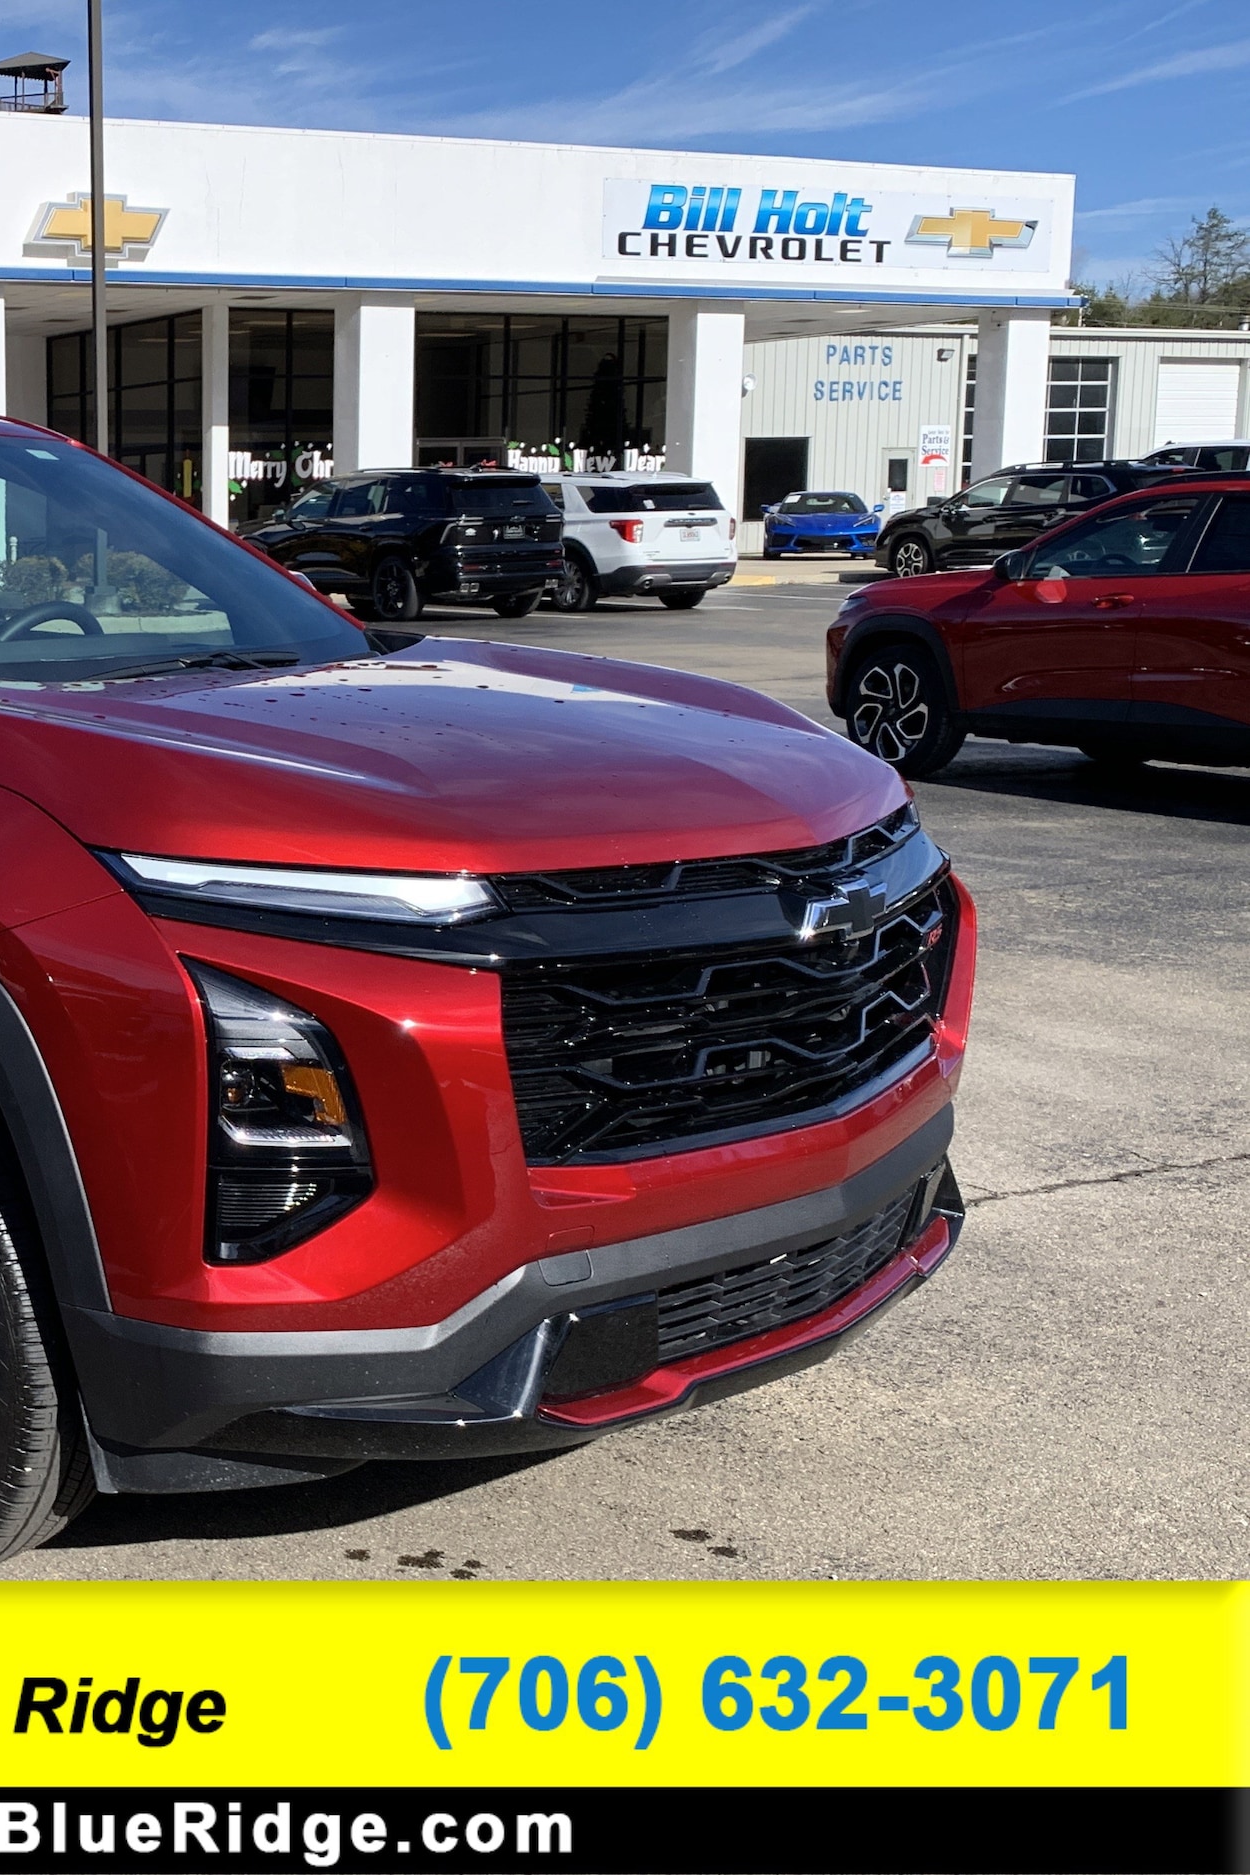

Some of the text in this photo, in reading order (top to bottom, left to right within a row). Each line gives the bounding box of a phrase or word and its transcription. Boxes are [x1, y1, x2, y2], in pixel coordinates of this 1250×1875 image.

[642, 185, 873, 237] Bill Holt
[618, 231, 892, 264] CHEVROLET
[826, 344, 893, 366] PARTS
[813, 380, 903, 401] SERVICE
[921, 445, 949, 455] Service
[922, 433, 942, 444] Parts
[228, 451, 287, 488] Merry
[573, 449, 617, 473] New
[927, 922, 944, 946] RS
